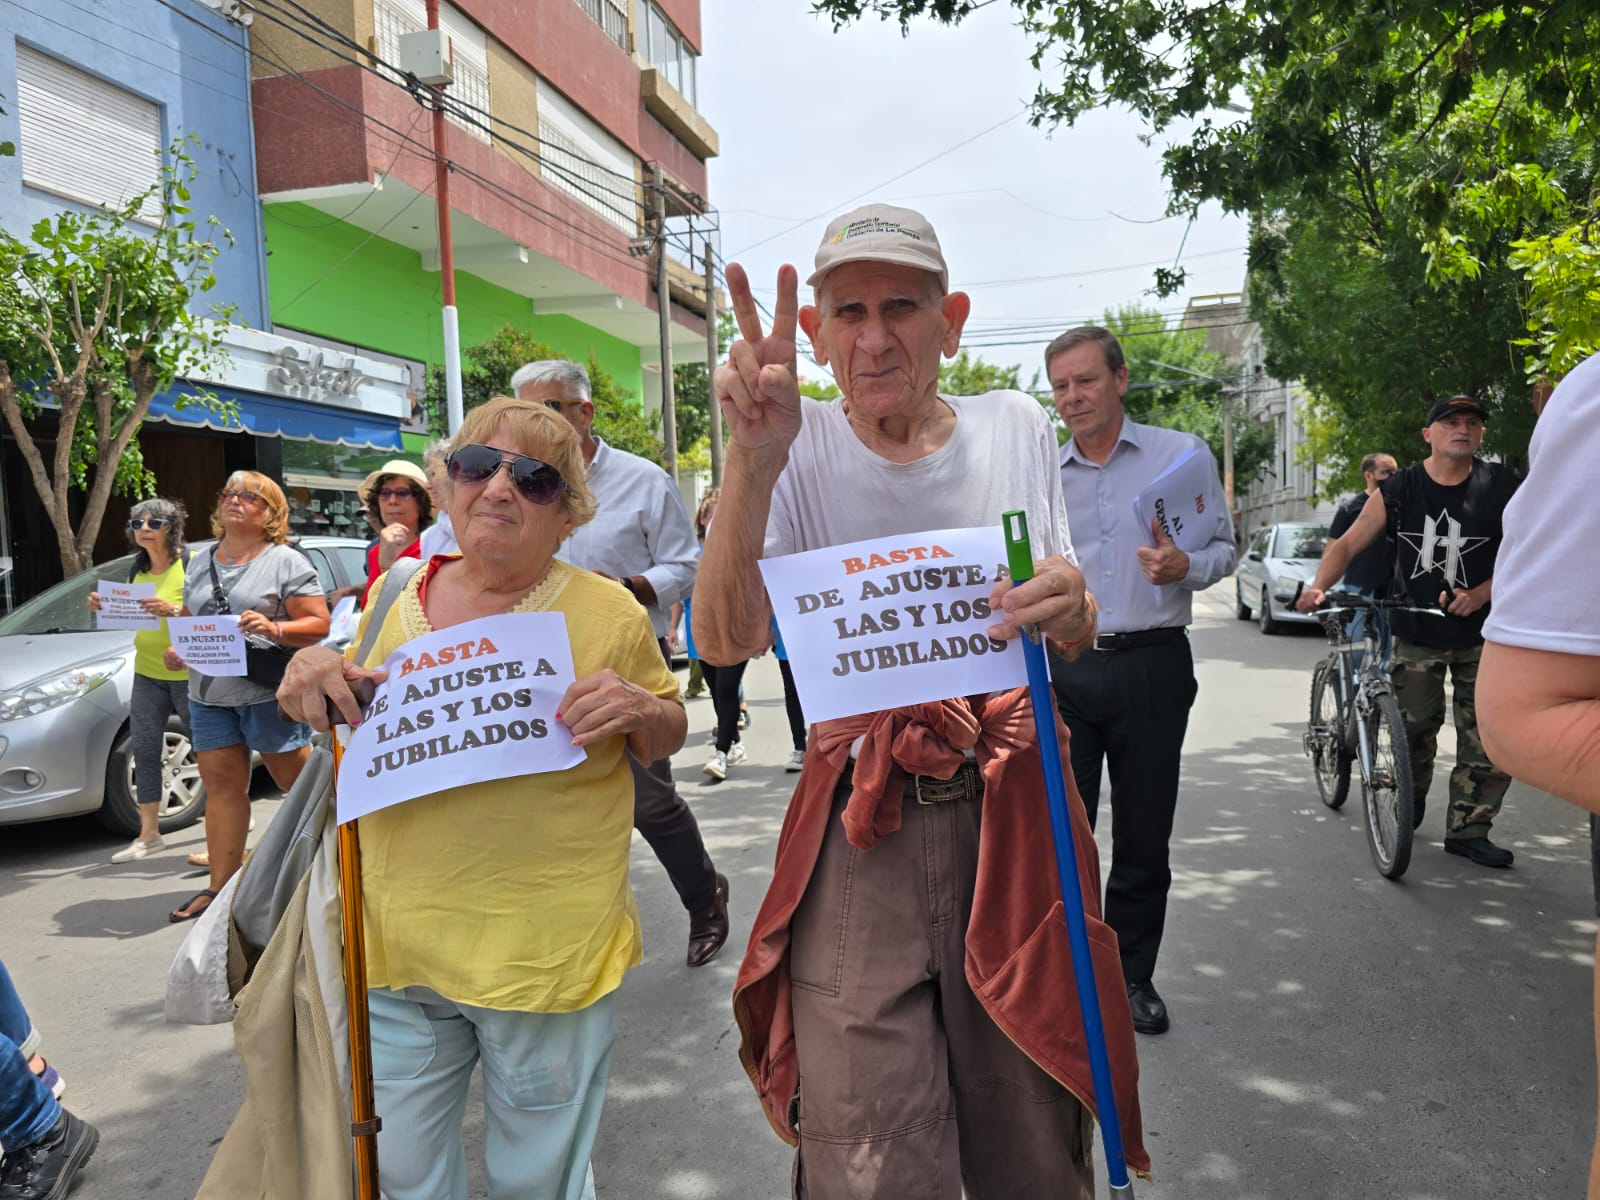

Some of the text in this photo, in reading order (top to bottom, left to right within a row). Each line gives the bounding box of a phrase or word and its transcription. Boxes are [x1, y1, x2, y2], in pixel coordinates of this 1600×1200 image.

[1195, 492, 1205, 514] NO
[1171, 516, 1184, 536] AL
[841, 545, 955, 576] BASTA
[794, 587, 845, 615] DE
[859, 563, 987, 601] AJUSTE
[178, 634, 236, 643] ES NUESTRO
[193, 624, 216, 632] PAMI
[833, 597, 992, 640] LAS Y LOS
[399, 637, 499, 679] BASTA
[832, 633, 1008, 677] JUBILADOS
[401, 660, 527, 706] AJUSTE
[533, 658, 558, 677] A
[376, 688, 533, 744] LAS Y LOS
[366, 718, 549, 778] JUBILADOS
